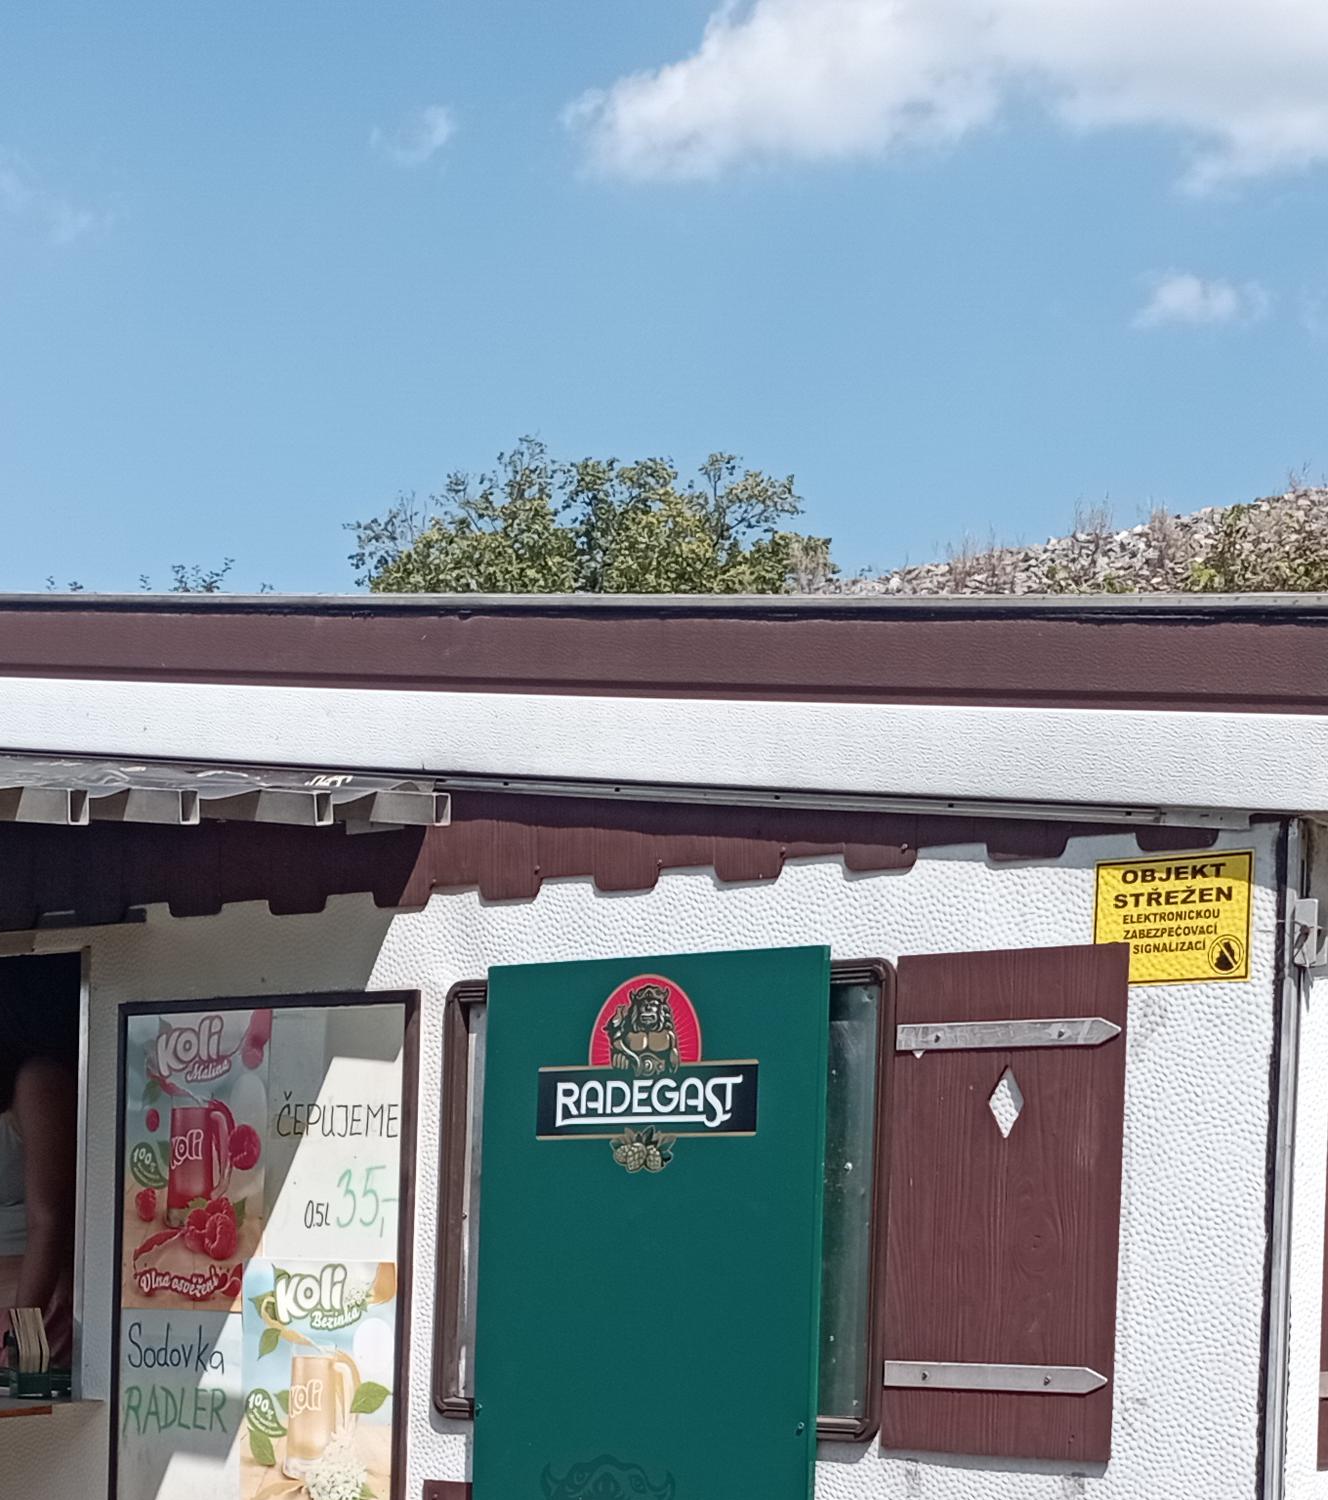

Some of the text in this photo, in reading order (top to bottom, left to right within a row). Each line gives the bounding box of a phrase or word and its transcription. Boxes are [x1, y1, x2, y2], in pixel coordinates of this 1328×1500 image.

[1122, 863, 1226, 884] OBJEKT
[1113, 885, 1233, 909] STŘEŽEN
[1123, 908, 1220, 925] ELEKTRONICKOU
[1123, 922, 1218, 940] ZABEZPEČOVACÍ
[1133, 938, 1206, 955] SIGNALIZACÍ
[157, 1015, 223, 1077] Koli
[277, 1091, 399, 1138] ČEPUJEME
[555, 1074, 743, 1127] RADEGAST
[274, 1263, 347, 1325] Koli
[311, 1305, 360, 1330] Bezinka
[128, 1322, 225, 1374] Sodovka
[122, 1384, 228, 1437] RADLER
